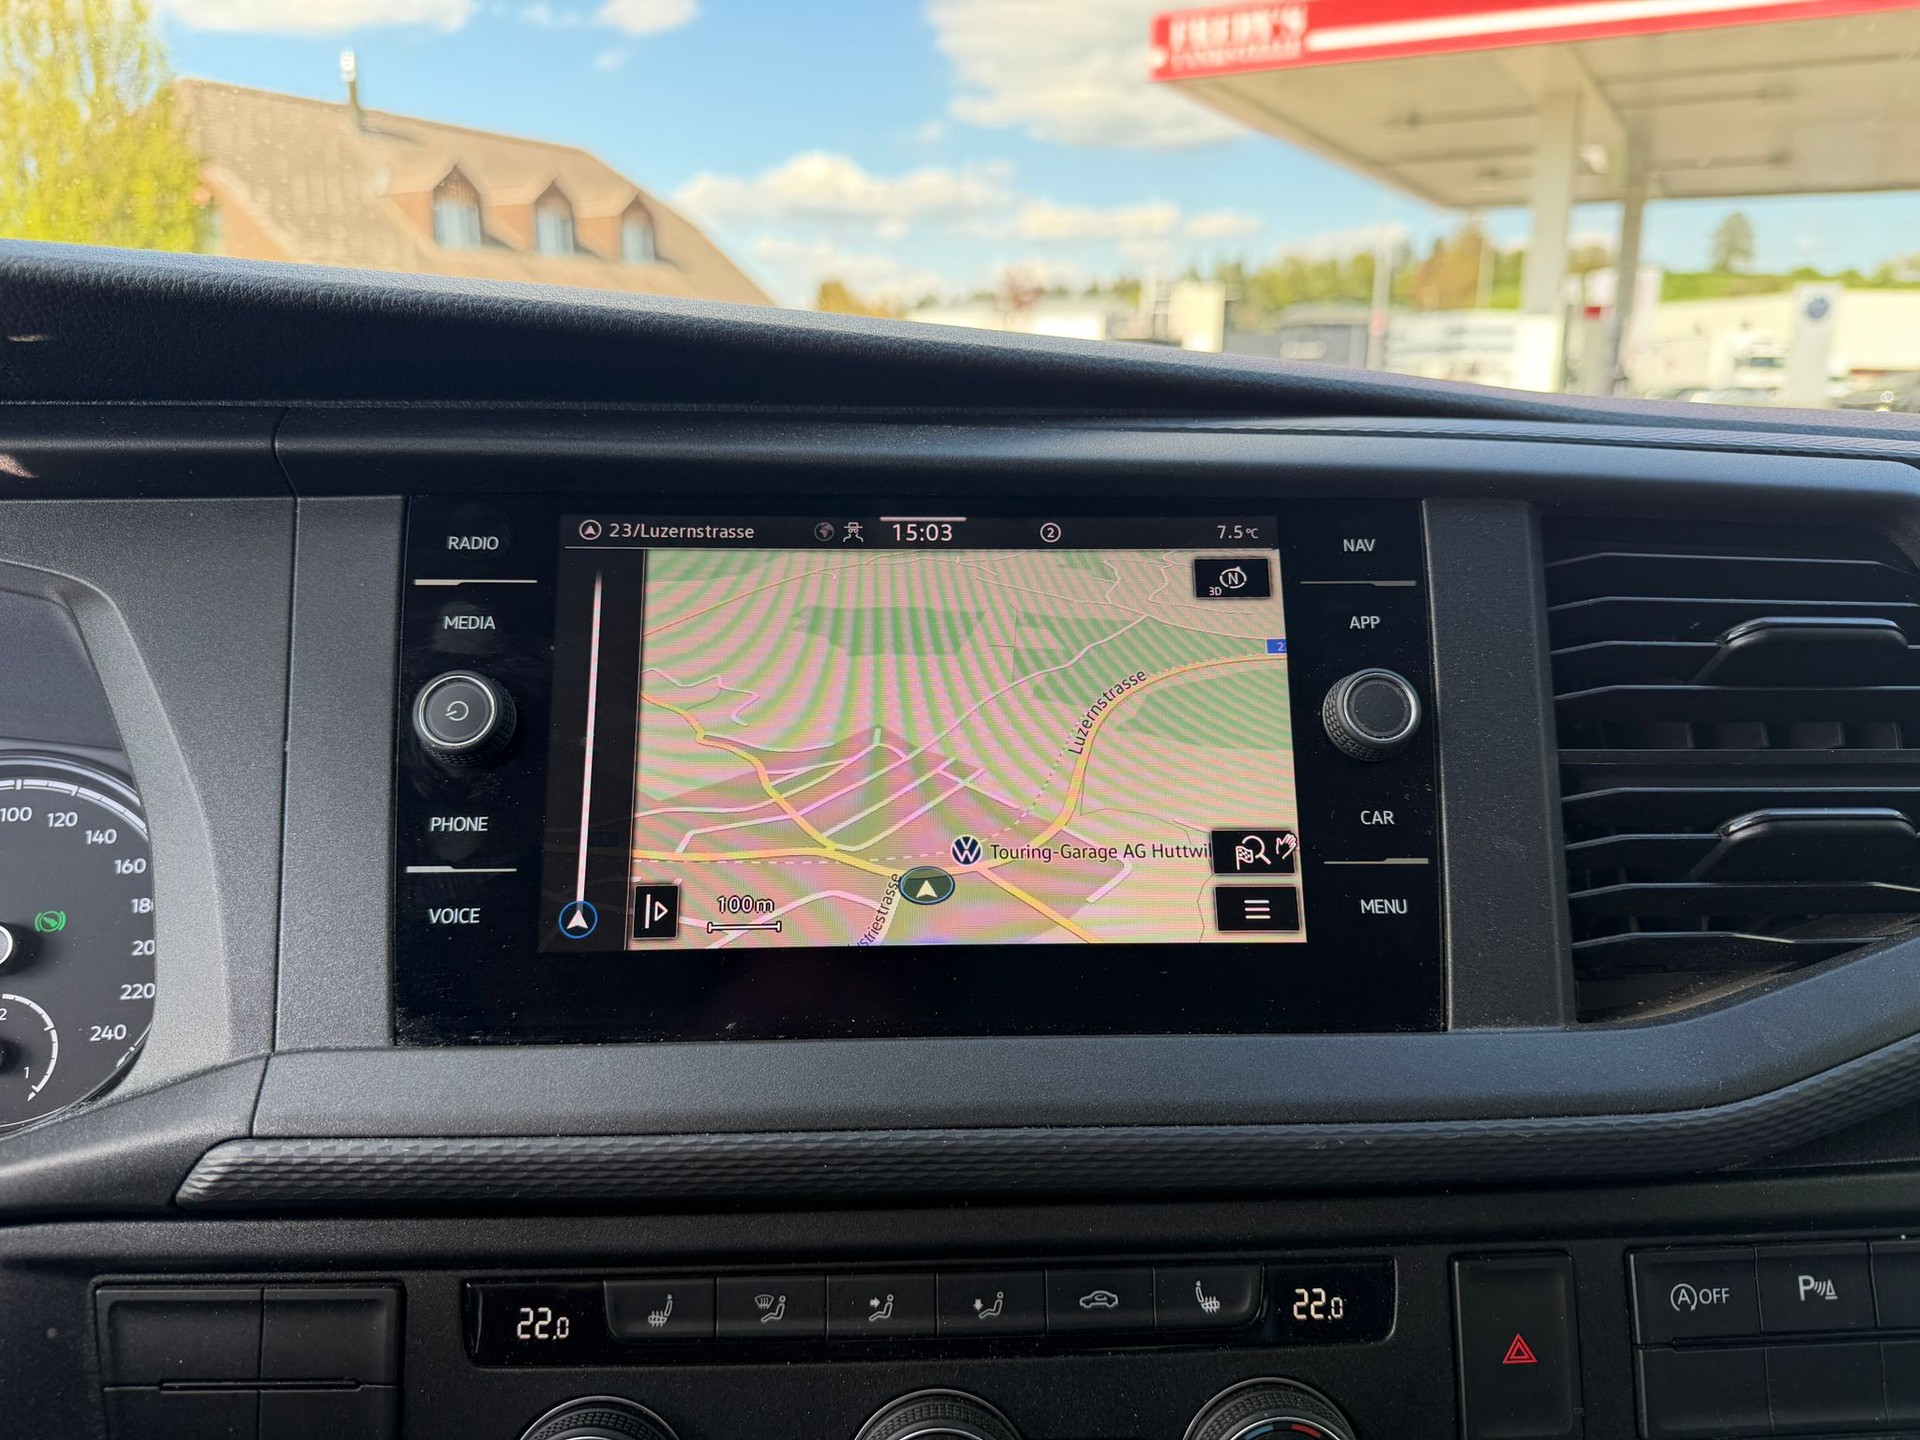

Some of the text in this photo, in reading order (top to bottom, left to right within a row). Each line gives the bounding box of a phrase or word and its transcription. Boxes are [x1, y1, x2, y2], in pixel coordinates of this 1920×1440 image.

[608, 523, 755, 540] 23/Luzernstrasse
[892, 523, 954, 542] 15:03
[448, 536, 499, 550] RADIO
[1343, 538, 1376, 553] NAV
[1227, 572, 1239, 585] N
[1208, 586, 1222, 596] 3D
[444, 616, 496, 630] MEDIA
[1349, 615, 1380, 630] APP
[1067, 670, 1147, 755] Luzernstrasse
[0, 806, 33, 823] 100
[47, 811, 78, 828] 120
[1360, 810, 1395, 825] CAR
[430, 816, 489, 832] PHONE
[85, 828, 118, 845] 140
[990, 842, 1212, 863] Touring-Garage AG Huttwil
[114, 858, 147, 875] 160
[131, 897, 154, 914] 18
[847, 873, 900, 947] striestrasse
[1361, 899, 1408, 914] MENU
[428, 907, 481, 924] VOICE
[131, 939, 156, 956] 20
[119, 982, 156, 1000] 220
[89, 1024, 127, 1042] 240
[24, 1066, 31, 1079] 1
[1699, 1287, 1731, 1305] OFF
